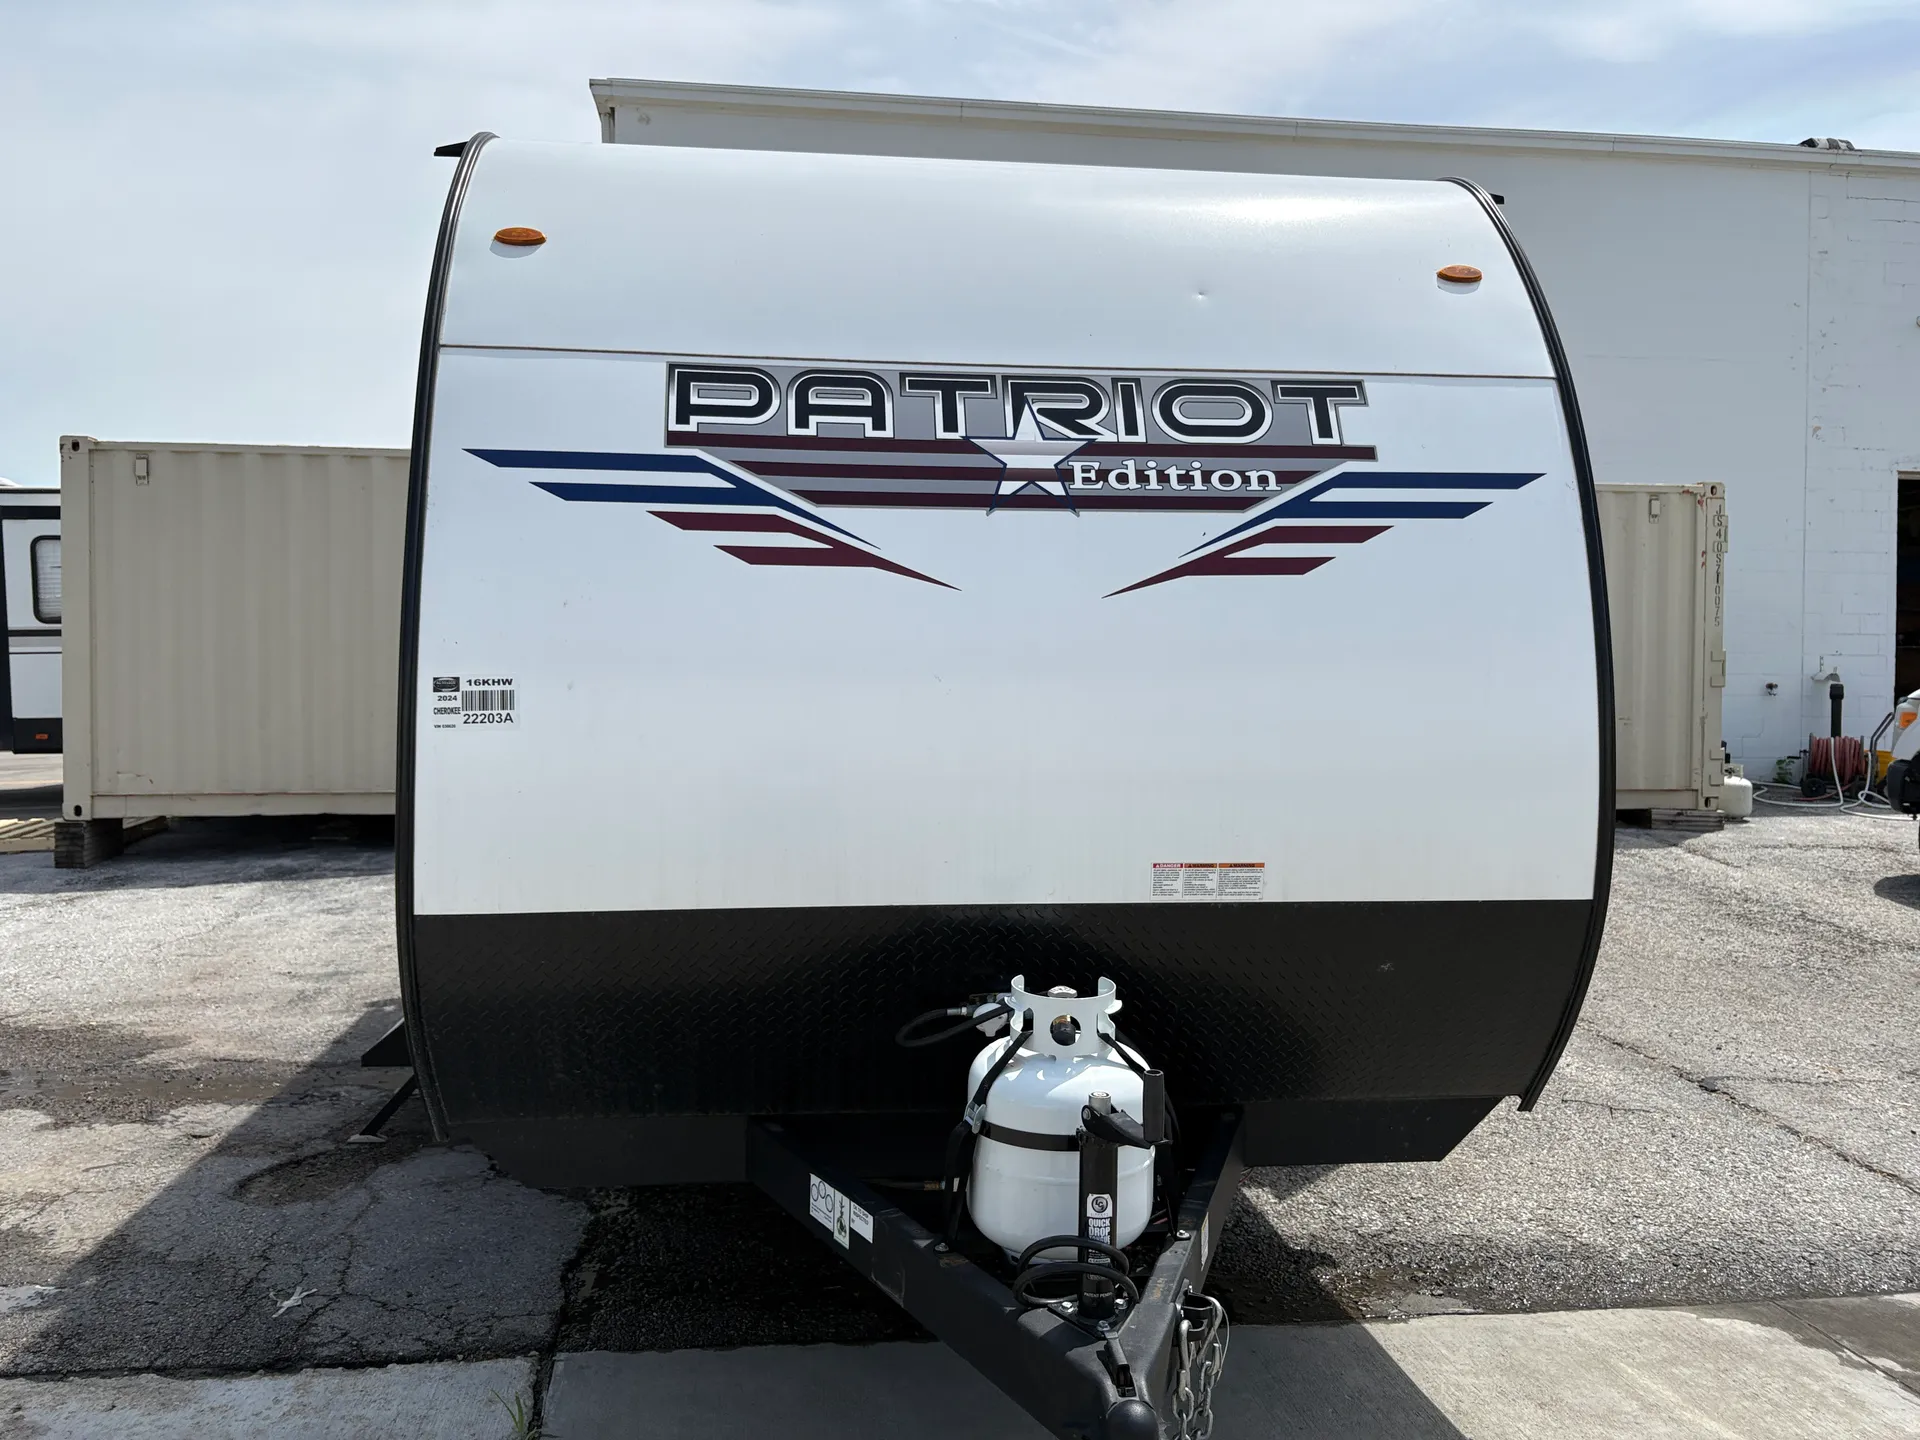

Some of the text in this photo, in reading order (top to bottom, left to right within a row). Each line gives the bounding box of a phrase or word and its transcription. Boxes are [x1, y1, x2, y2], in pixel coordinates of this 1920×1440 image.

[668, 365, 1367, 445] PATRIOT
[1070, 460, 1282, 492] Edition
[466, 678, 513, 686] 16KHW
[433, 707, 461, 715] CHEROKEE
[463, 713, 514, 724] 22203A
[1089, 1218, 1110, 1227] QUICK
[1089, 1227, 1110, 1236] DROP
